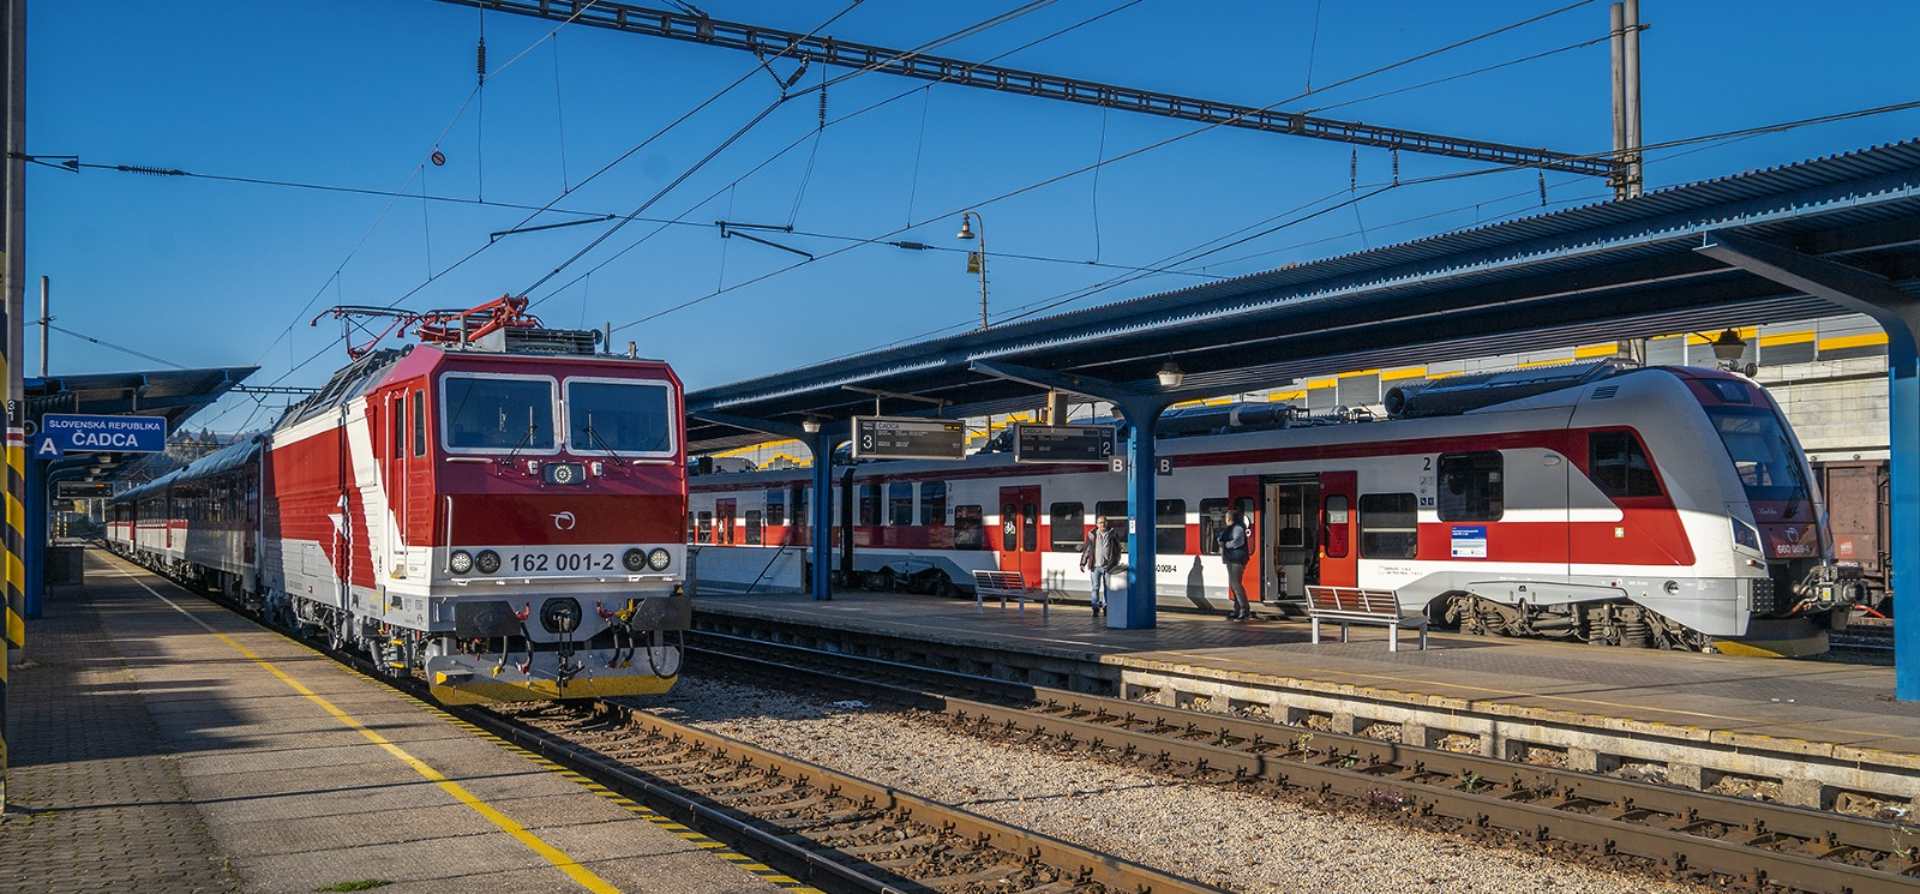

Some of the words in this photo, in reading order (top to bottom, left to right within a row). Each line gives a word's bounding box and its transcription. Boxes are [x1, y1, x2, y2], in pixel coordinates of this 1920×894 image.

[108, 421, 160, 430] REPUBLIKA
[72, 429, 138, 447] ČADCA
[863, 434, 872, 448] 3
[39, 437, 58, 455] A
[1103, 441, 1111, 455] 2
[1113, 459, 1123, 472] B
[1160, 459, 1170, 472] B
[1424, 457, 1431, 470] 2
[510, 554, 548, 571] 162
[556, 553, 614, 570] 001-2
